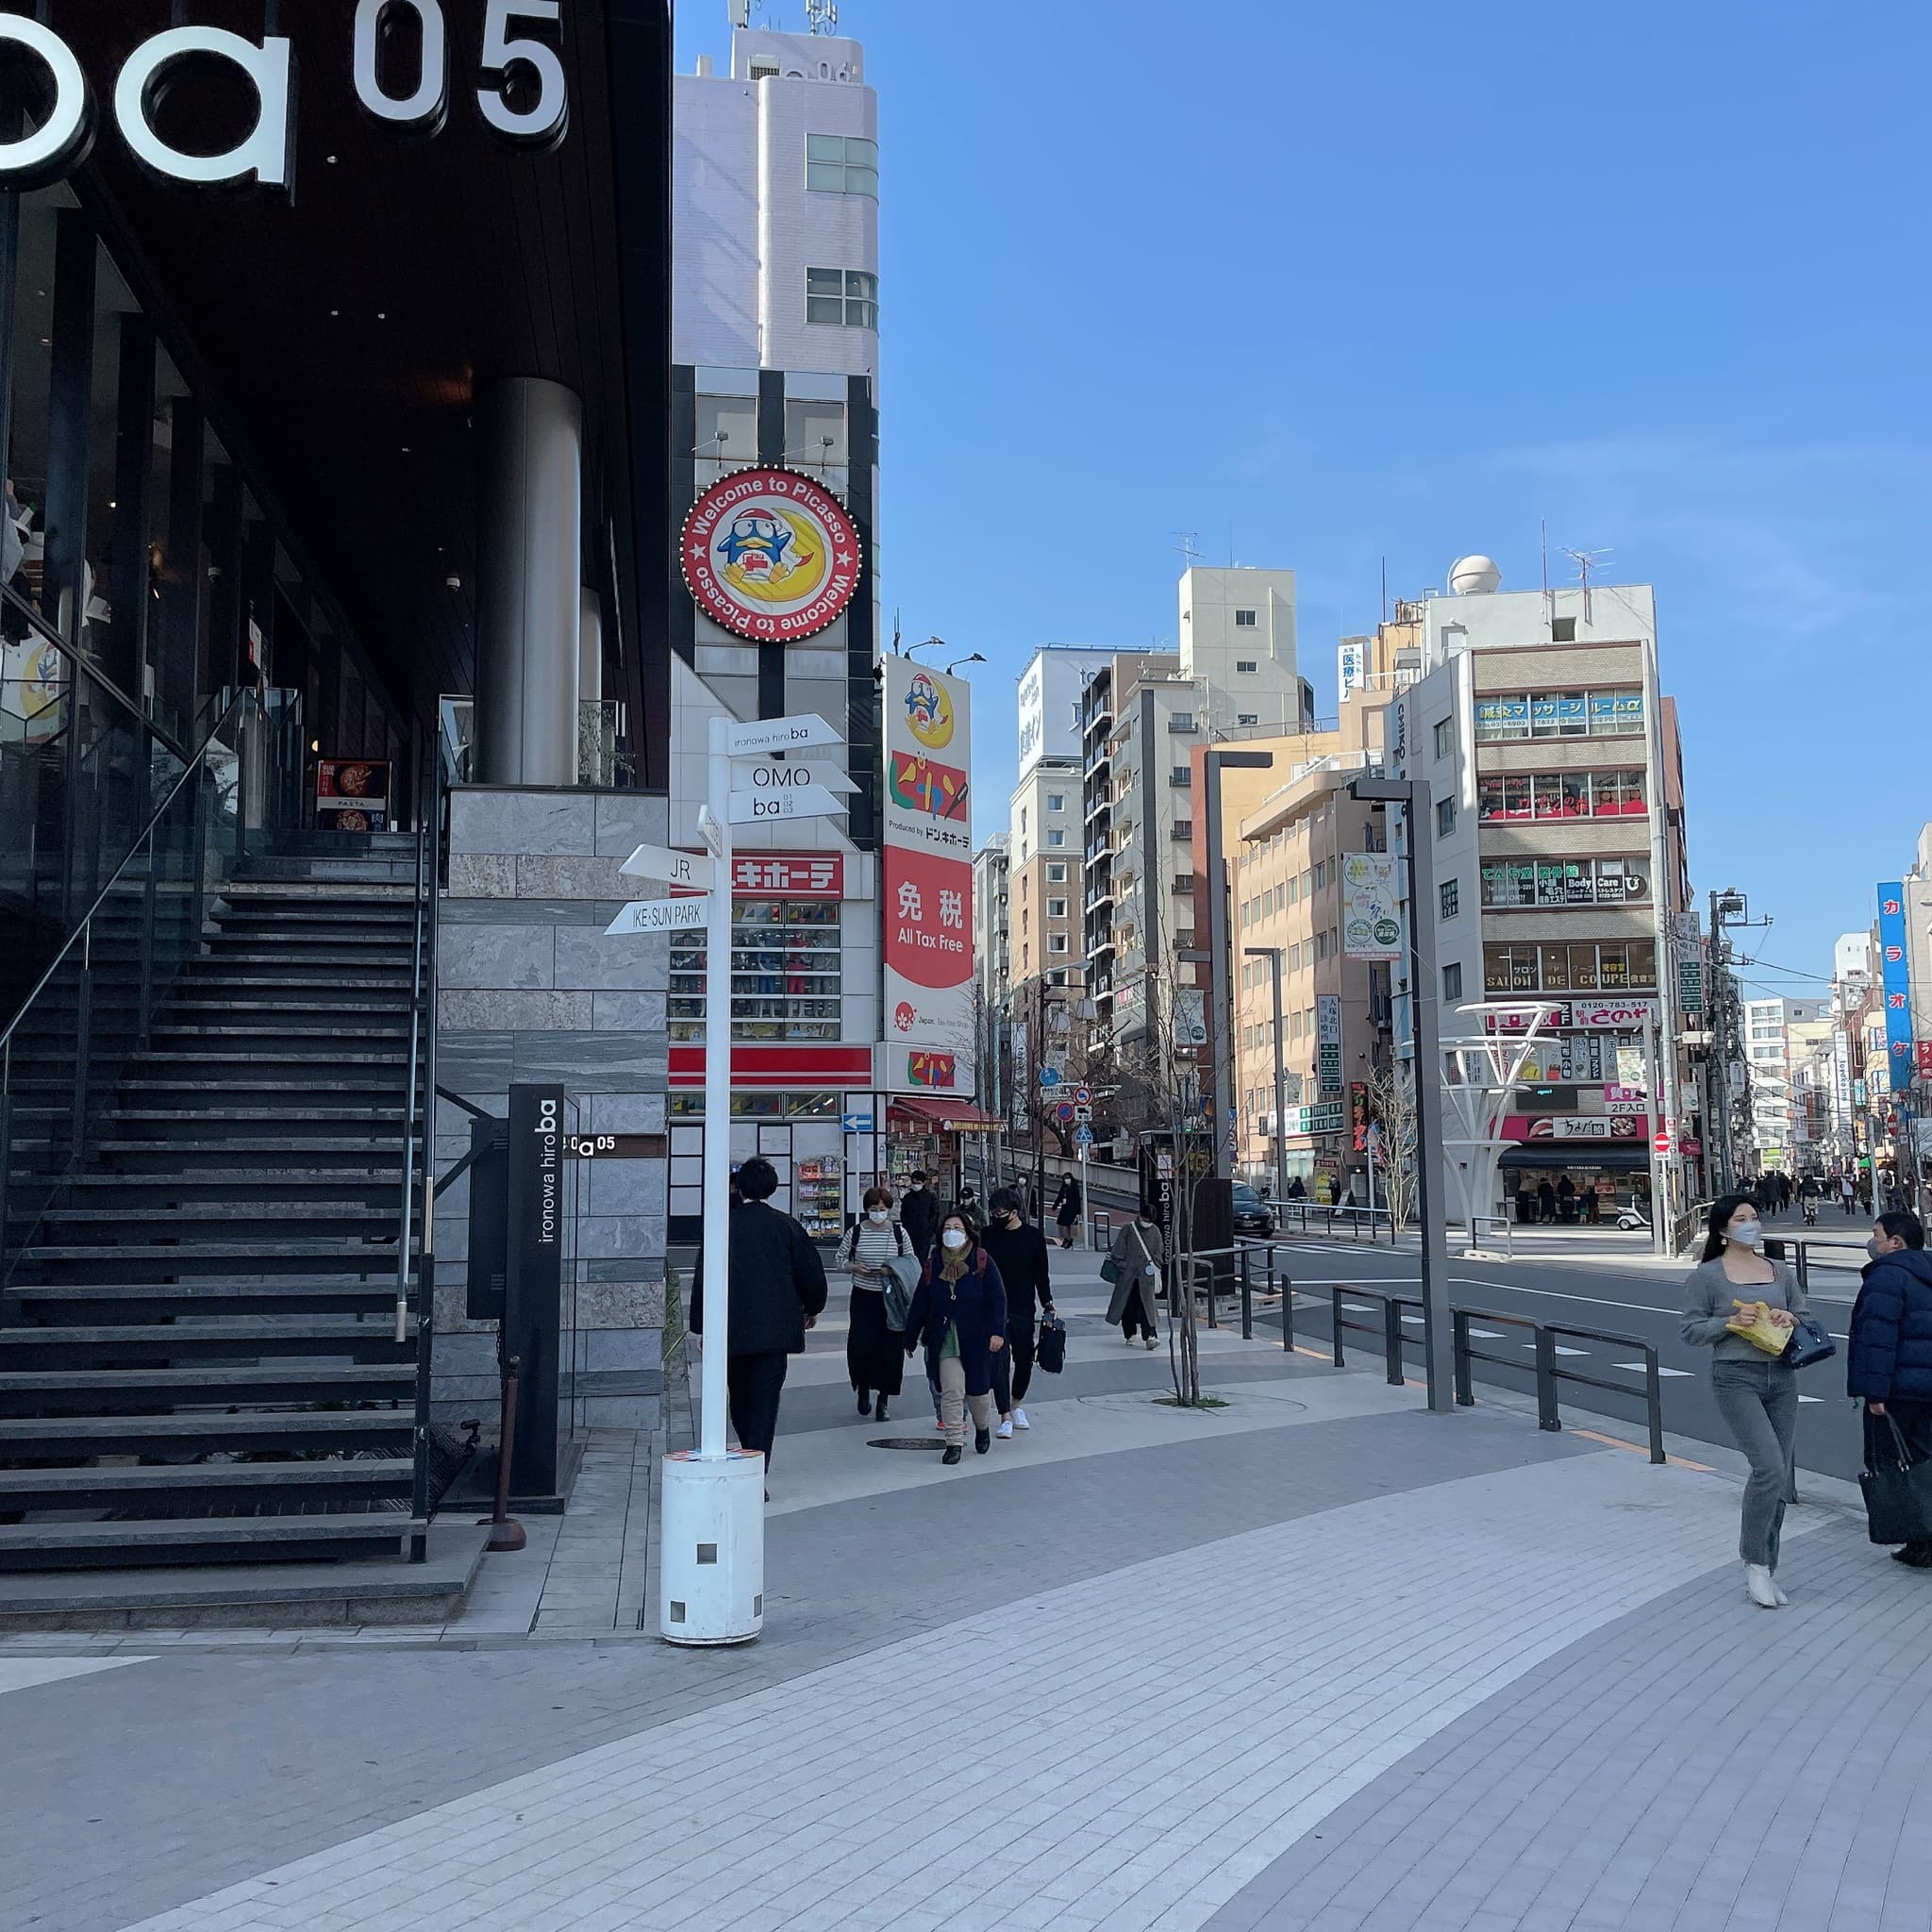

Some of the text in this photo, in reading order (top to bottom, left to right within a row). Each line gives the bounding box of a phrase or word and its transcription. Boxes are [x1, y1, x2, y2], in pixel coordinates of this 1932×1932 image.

[353, 0, 568, 135] 05
[691, 476, 846, 543] Welcome to Picasso
[696, 567, 851, 634] Welcome to Picasso
[772, 727, 808, 743] hiroba
[753, 768, 810, 787] OMO
[753, 797, 780, 816] ba
[889, 820, 916, 834] Produced
[916, 826, 924, 837] by
[670, 858, 691, 881] JR
[1568, 877, 1619, 890] Body Care
[675, 903, 702, 924] PARK
[897, 927, 963, 953] All Tax Free
[1547, 975, 1566, 986] DE
[1579, 974, 1628, 985] COUPE
[1884, 899, 1908, 1058] カラオケ
[1611, 1103, 1646, 1113] 2F入口
[596, 1136, 616, 1150] 05
[534, 1099, 557, 1243] ironowa hiroba
[1158, 1182, 1171, 1222] hiroba
